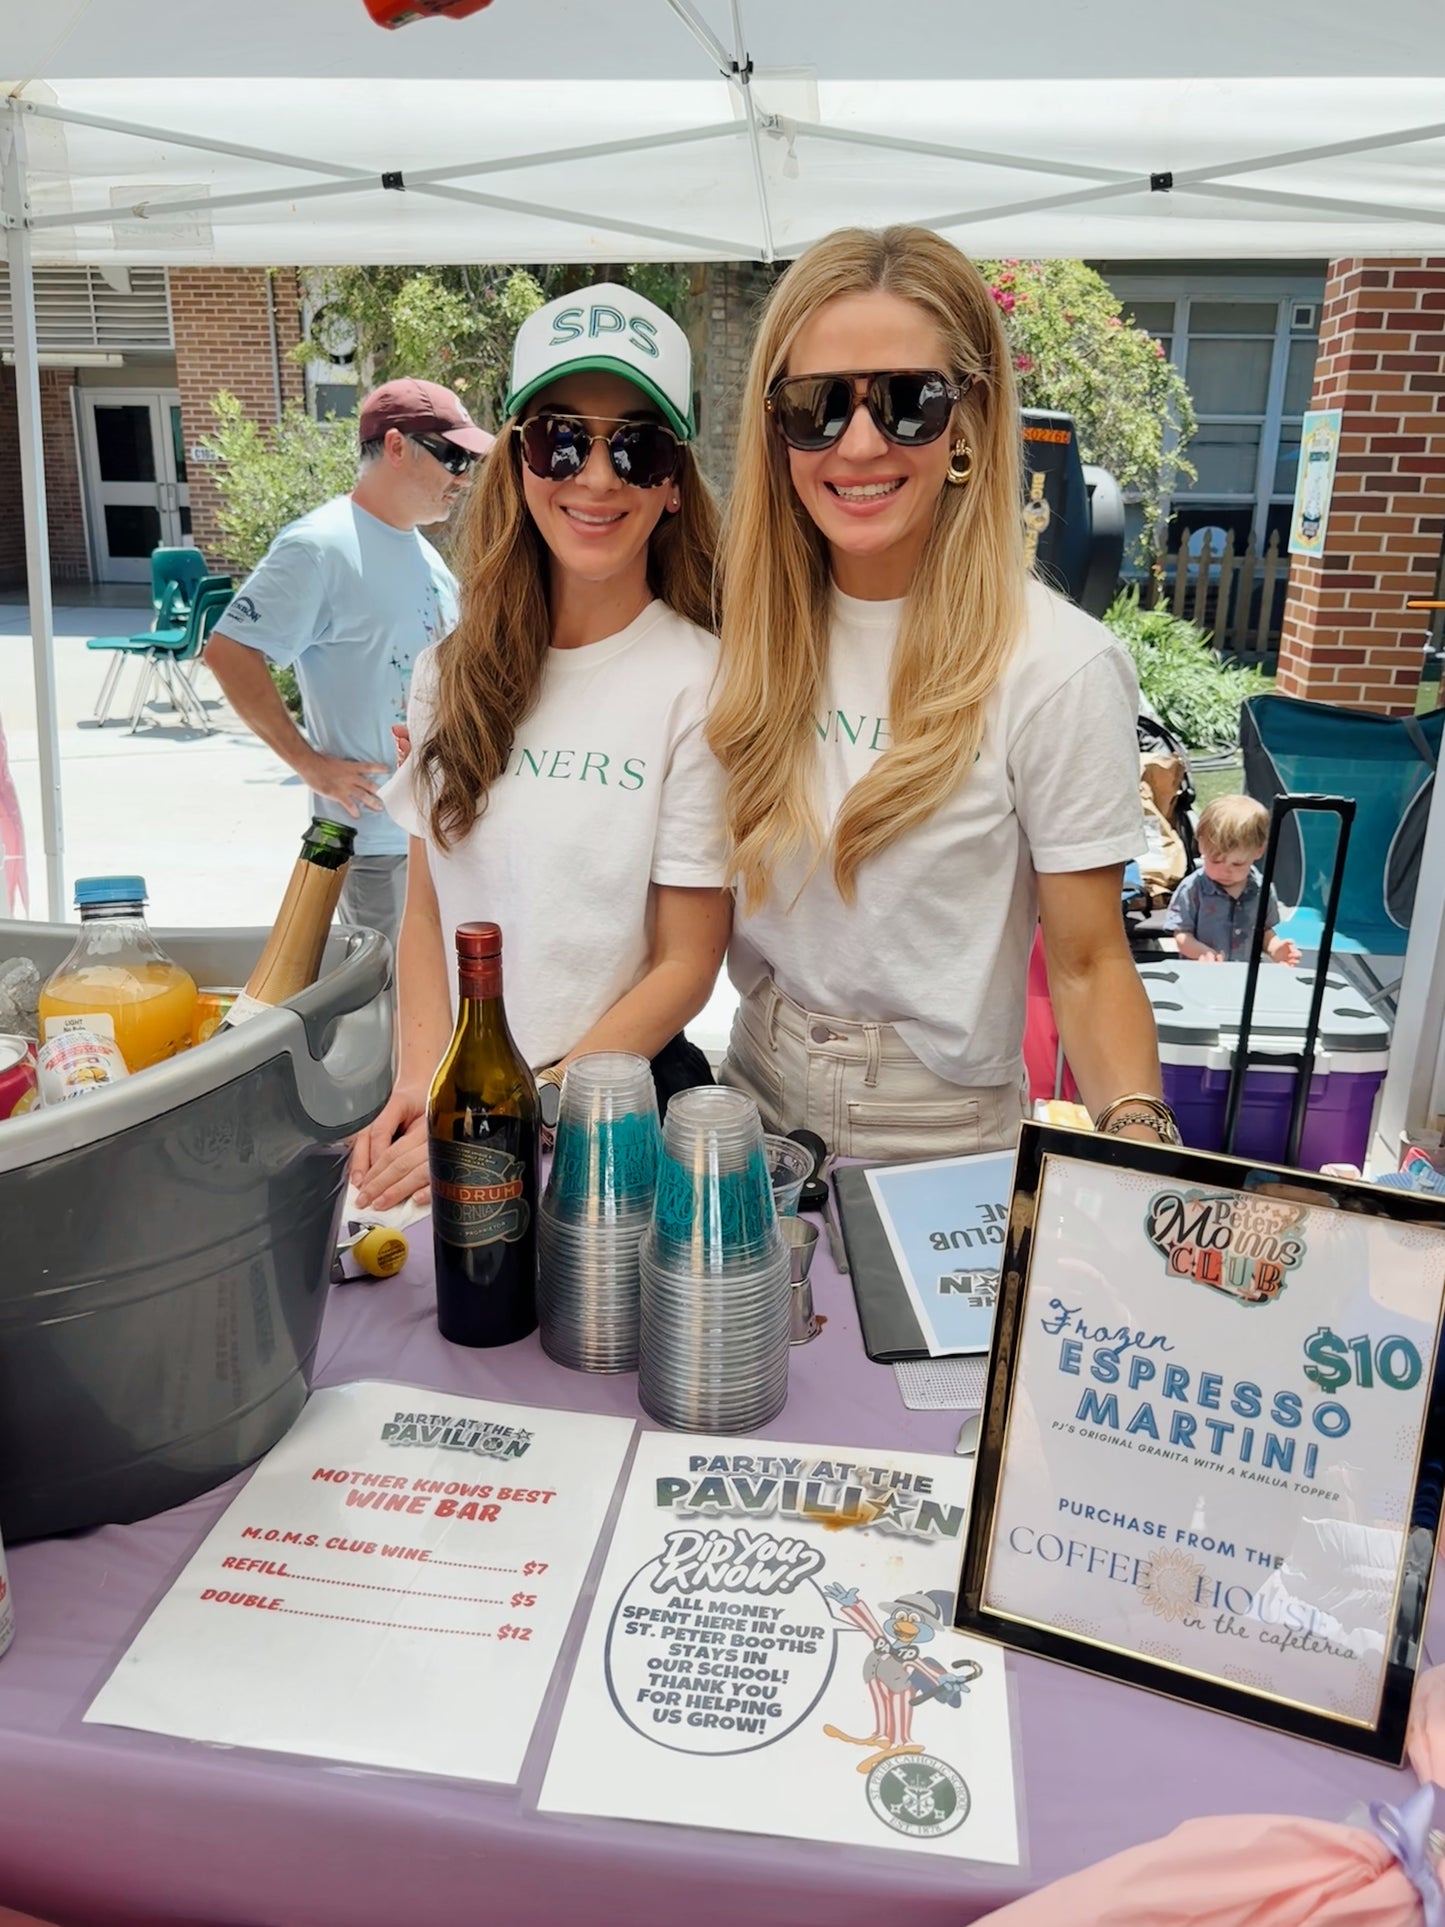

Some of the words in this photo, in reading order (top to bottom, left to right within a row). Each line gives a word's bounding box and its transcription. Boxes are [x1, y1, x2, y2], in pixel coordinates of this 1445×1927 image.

[549, 305, 660, 358] SPS
[1031, 472, 1046, 500] BIG
[503, 748, 647, 791] NERS
[64, 1018, 83, 1027] LIGHT
[1212, 1200, 1279, 1235] Peter
[929, 1225, 1005, 1251] CLUB
[1171, 1247, 1281, 1293] CLUB
[1041, 1298, 1175, 1355] Frozen
[1303, 1327, 1422, 1394] $10
[1059, 1338, 1351, 1438] ESPRESSO
[393, 1412, 451, 1426] PARTY
[455, 1418, 476, 1429] AT
[483, 1422, 514, 1437] THE
[1075, 1387, 1319, 1479] MARTINI
[689, 1455, 801, 1475] PARTY
[811, 1460, 856, 1480] AT
[868, 1466, 934, 1495] THE
[1051, 1421, 1075, 1434] PJ'S
[1079, 1428, 1133, 1449] ORIGINAL
[1138, 1444, 1189, 1463] GRANITA
[1194, 1458, 1224, 1472] WITH
[1227, 1467, 1235, 1475] A
[1240, 1469, 1288, 1488] KAHLUA
[1294, 1483, 1340, 1501] TOPPER
[312, 1468, 408, 1489] MOTHER
[412, 1479, 493, 1498] KNOWS
[497, 1487, 557, 1504] BEST
[345, 1489, 432, 1514] WINE
[434, 1499, 502, 1523] BAR
[241, 1527, 319, 1547] M.O.M.S.
[325, 1537, 377, 1554] CLUB
[522, 1560, 549, 1576] $7
[1058, 1498, 1167, 1540] PURCHASE
[1176, 1529, 1235, 1558] FROM
[1245, 1547, 1284, 1570] THE
[510, 1592, 537, 1608] $5
[1009, 1525, 1153, 1590] COFFEE
[1194, 1575, 1328, 1640] HOUSE
[623, 1605, 691, 1625] SPENT
[694, 1614, 746, 1632] HERE
[751, 1621, 776, 1635] IN
[780, 1624, 825, 1640] OUR
[668, 1596, 704, 1611] ALL
[708, 1601, 785, 1620] MONEY
[497, 1624, 533, 1641] $12
[624, 1621, 655, 1637] ST.
[661, 1626, 726, 1645] PETER
[730, 1634, 817, 1654] BOOTHS
[1183, 1613, 1206, 1630] in
[1214, 1614, 1249, 1639] the
[1259, 1624, 1357, 1660] cafeteria
[647, 1657, 693, 1673] OUR
[697, 1662, 789, 1685] SCHOOL!
[669, 1643, 738, 1662] STAYS
[742, 1650, 768, 1665] IN
[636, 1688, 682, 1706] FOR
[685, 1694, 782, 1717] HELPING
[648, 1673, 727, 1694] THANK
[732, 1682, 778, 1699] YOU
[652, 1708, 682, 1724] US
[687, 1712, 767, 1735] GROW!
[871, 1761, 893, 1786] PETER
[895, 1755, 947, 1773] CATHOLIC
